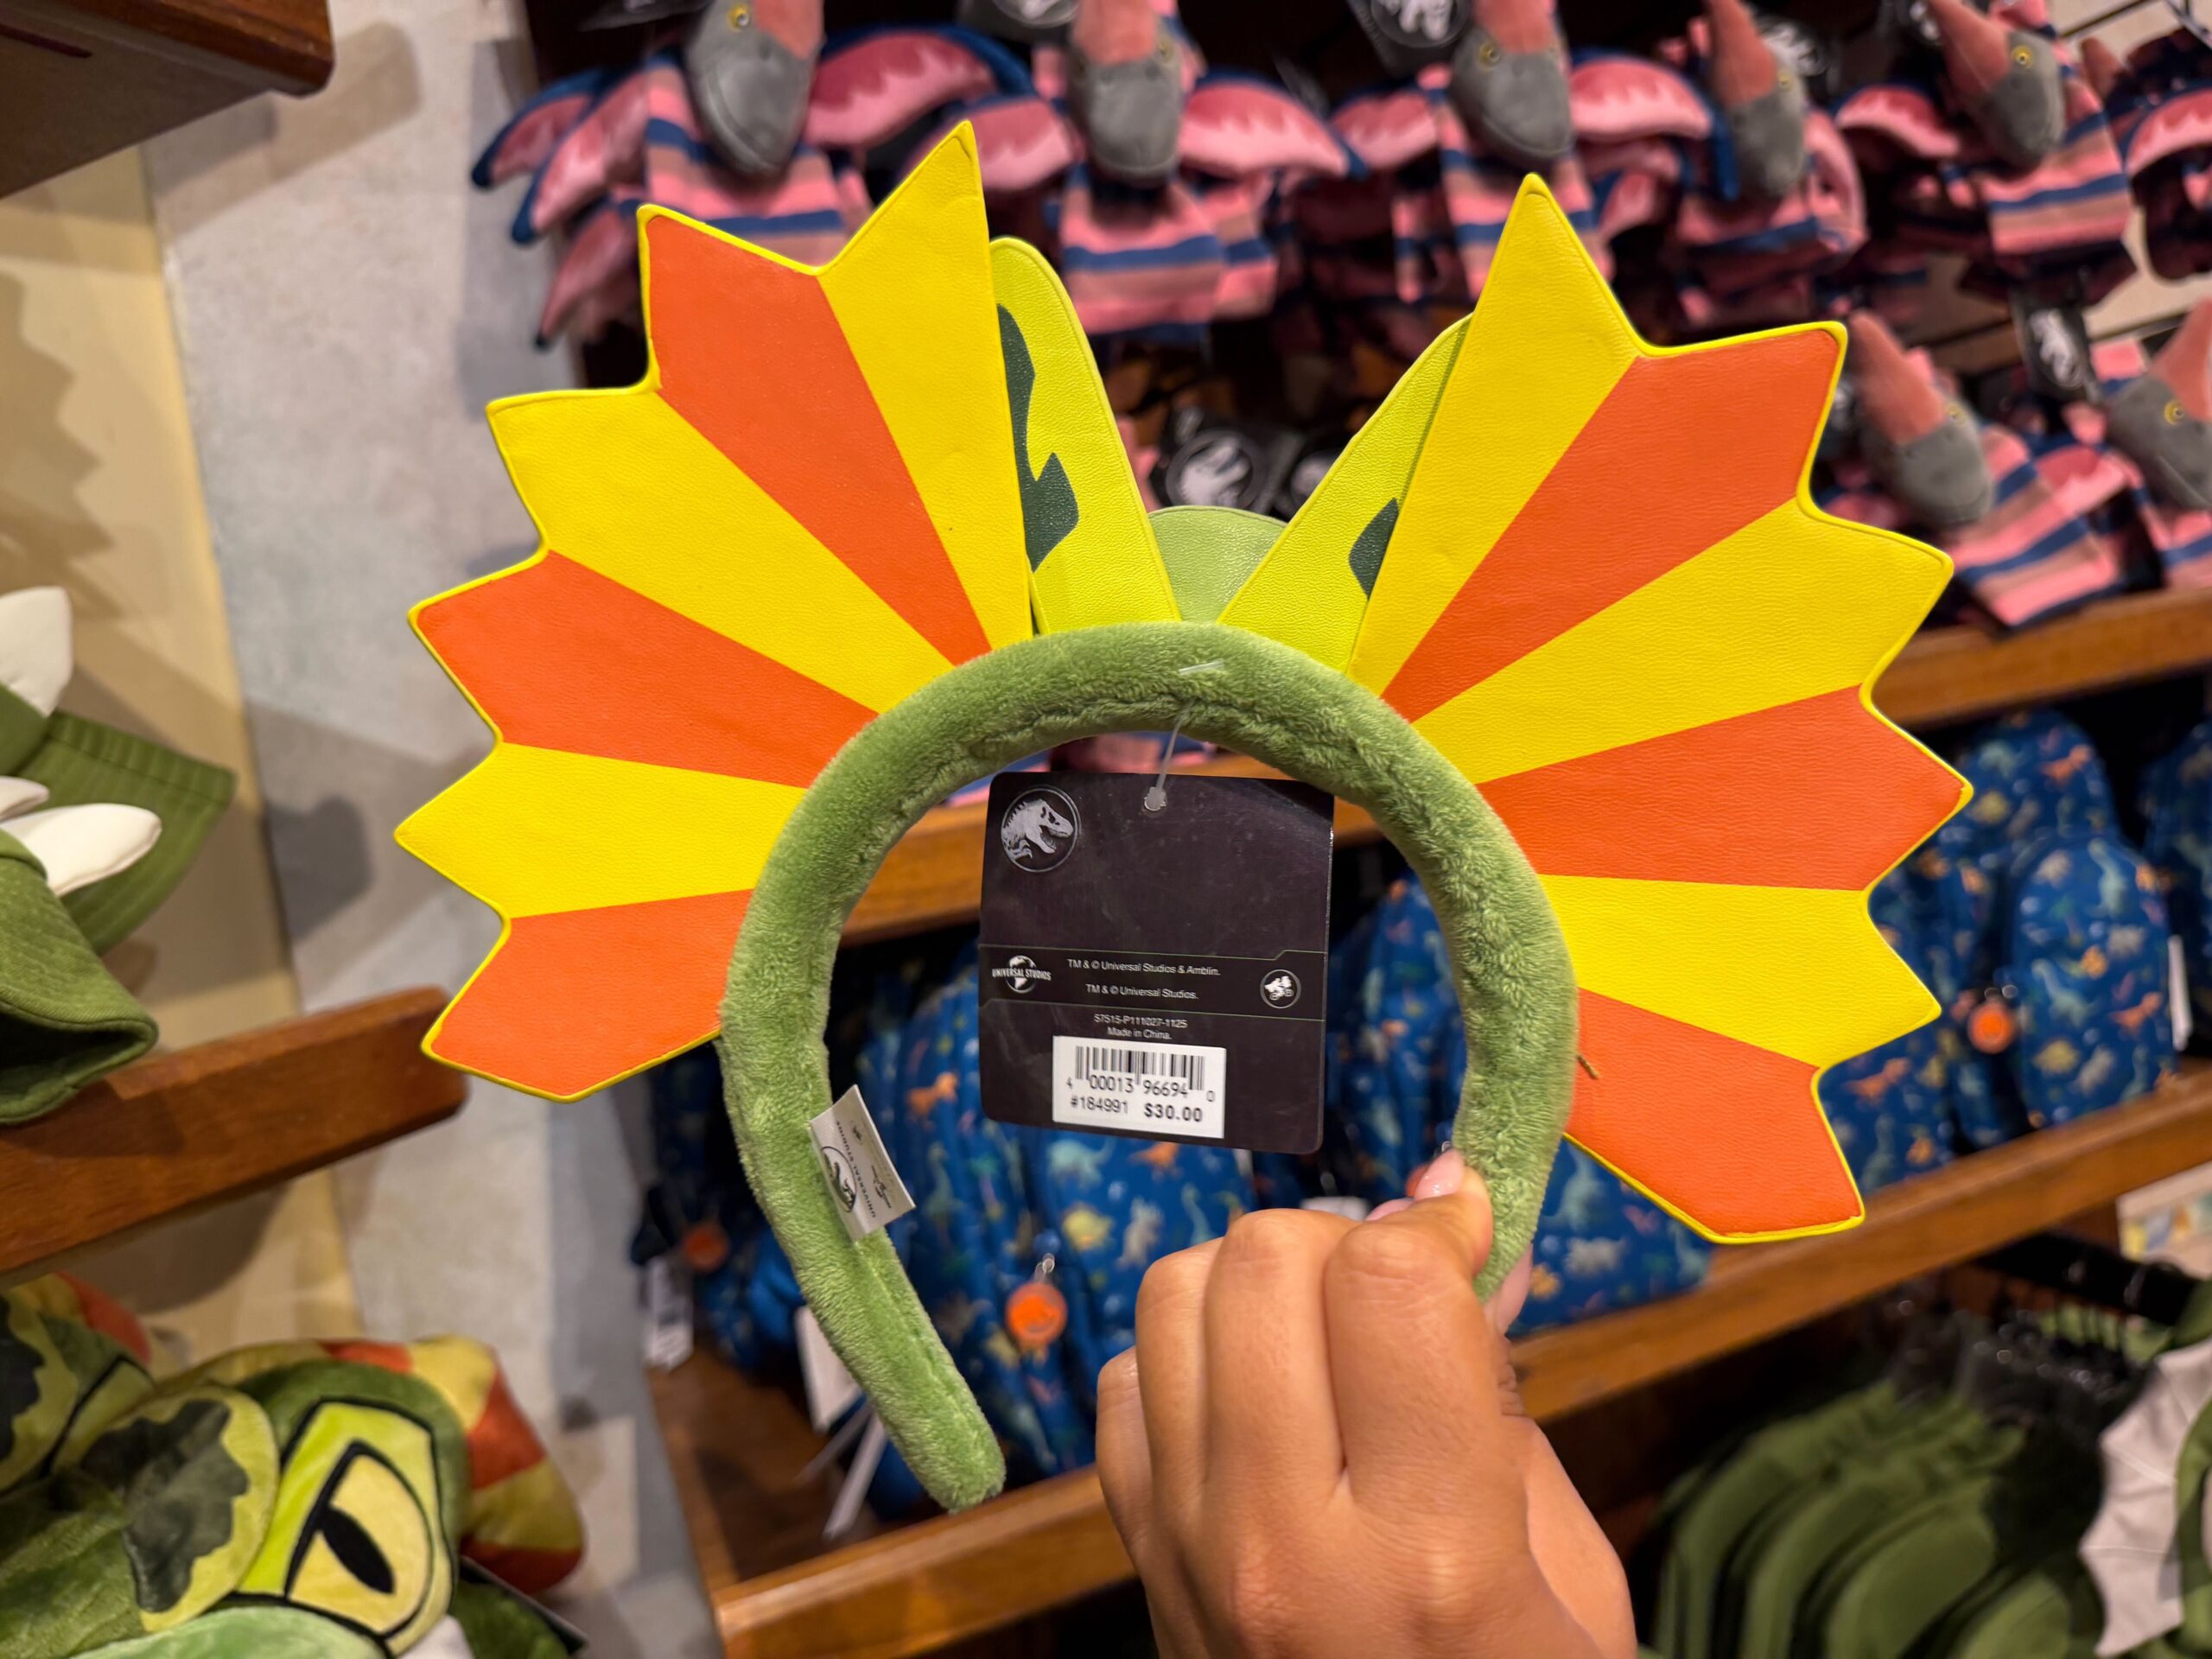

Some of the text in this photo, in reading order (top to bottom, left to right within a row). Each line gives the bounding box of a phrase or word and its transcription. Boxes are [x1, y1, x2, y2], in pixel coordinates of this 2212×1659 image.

[992, 968, 1052, 981] UNIVERSAL STUDIOS
[1067, 959, 1081, 968] TM
[1083, 960, 1090, 969] &
[1101, 960, 1141, 971] Universal
[1142, 963, 1176, 973] Studios
[1178, 965, 1185, 974] &
[1186, 965, 1221, 976] Amblin.
[1085, 984, 1100, 994] TM
[1101, 985, 1109, 994] &
[1120, 986, 1160, 997] Universal
[1162, 988, 1198, 999] Studios.
[1107, 1027, 1173, 1039] Made in China.
[1090, 1075, 1134, 1093] 00013
[1142, 1079, 1188, 1098] 96694
[1206, 1090, 1216, 1102] 0
[1071, 1096, 1203, 1122] #184991 $30.00
